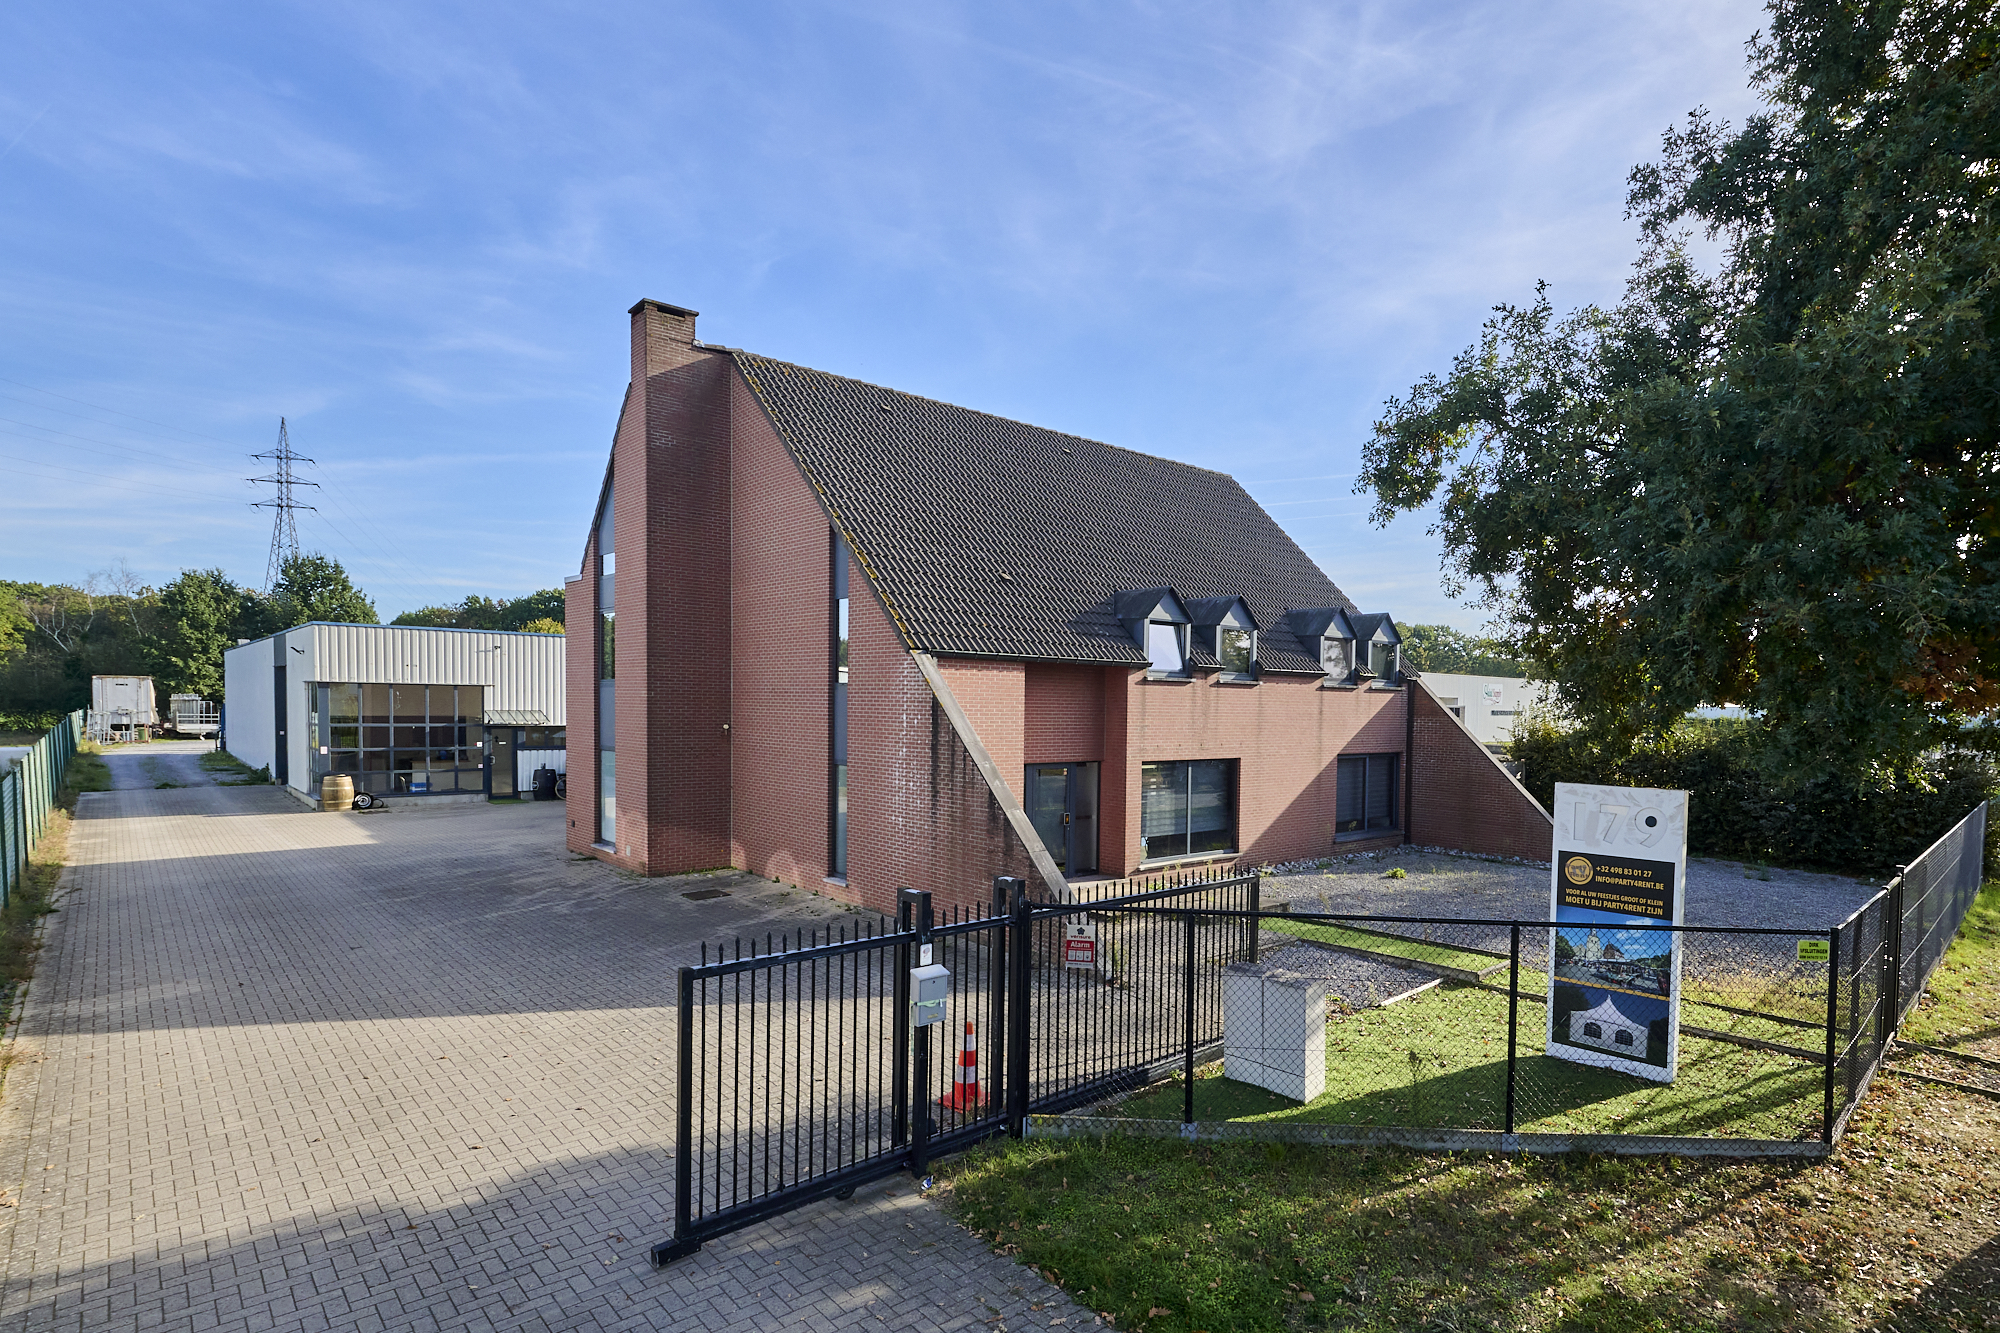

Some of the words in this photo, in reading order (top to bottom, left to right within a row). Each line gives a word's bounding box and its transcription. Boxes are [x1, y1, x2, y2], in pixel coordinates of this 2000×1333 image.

[1574, 802, 1668, 848] 179
[1624, 868, 1632, 876] 83
[1643, 870, 1652, 878] 27
[1595, 875, 1665, 890] INFO@PARTY4RENT.BE
[1597, 892, 1620, 900] FEESTJES
[1621, 895, 1638, 903] GROOT
[1565, 896, 1584, 904] MOET
[1591, 899, 1602, 907] BIJ
[1603, 901, 1646, 913] PARTY4RENT
[1646, 906, 1663, 916] ZIJN
